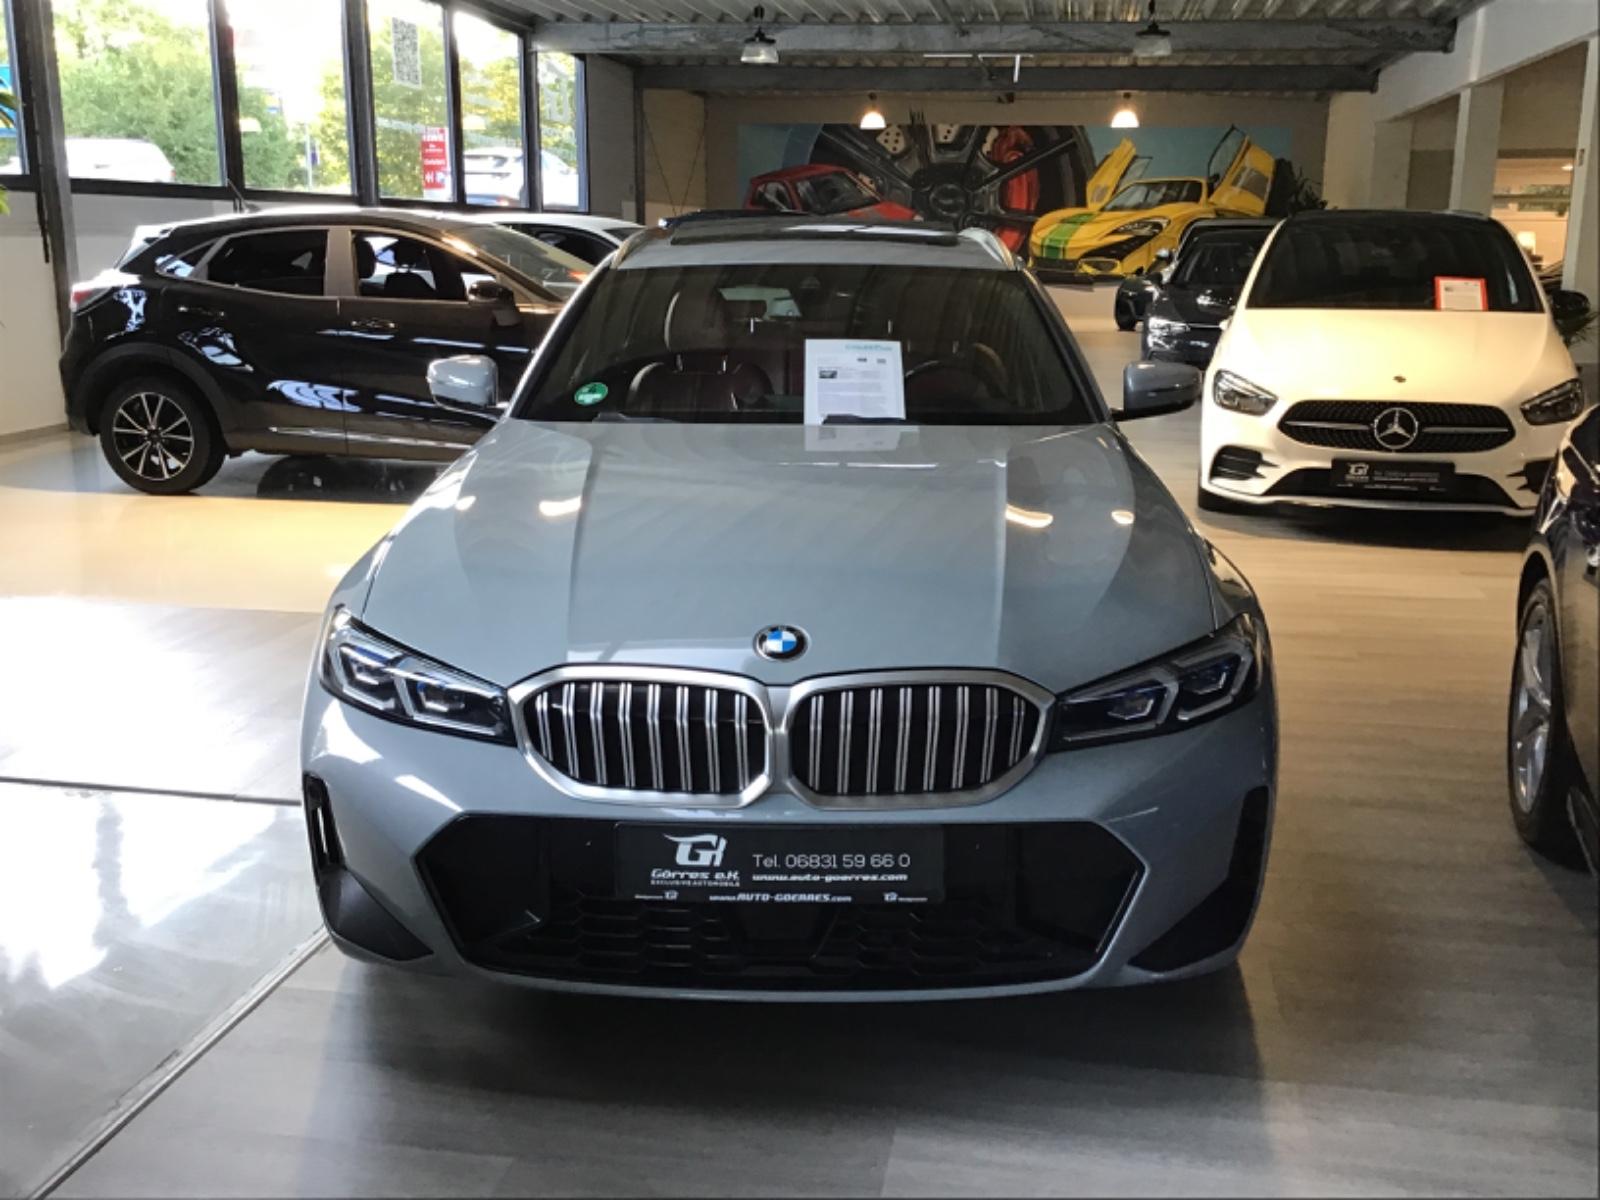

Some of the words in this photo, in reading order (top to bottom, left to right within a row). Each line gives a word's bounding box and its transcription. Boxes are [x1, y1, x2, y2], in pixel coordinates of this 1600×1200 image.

[752, 854, 780, 868] Tel.
[785, 854, 837, 868] 06831
[842, 854, 865, 868] 59
[870, 854, 894, 868] 66
[898, 854, 911, 868] 0
[752, 873, 908, 882] www.auto-goerres.com
